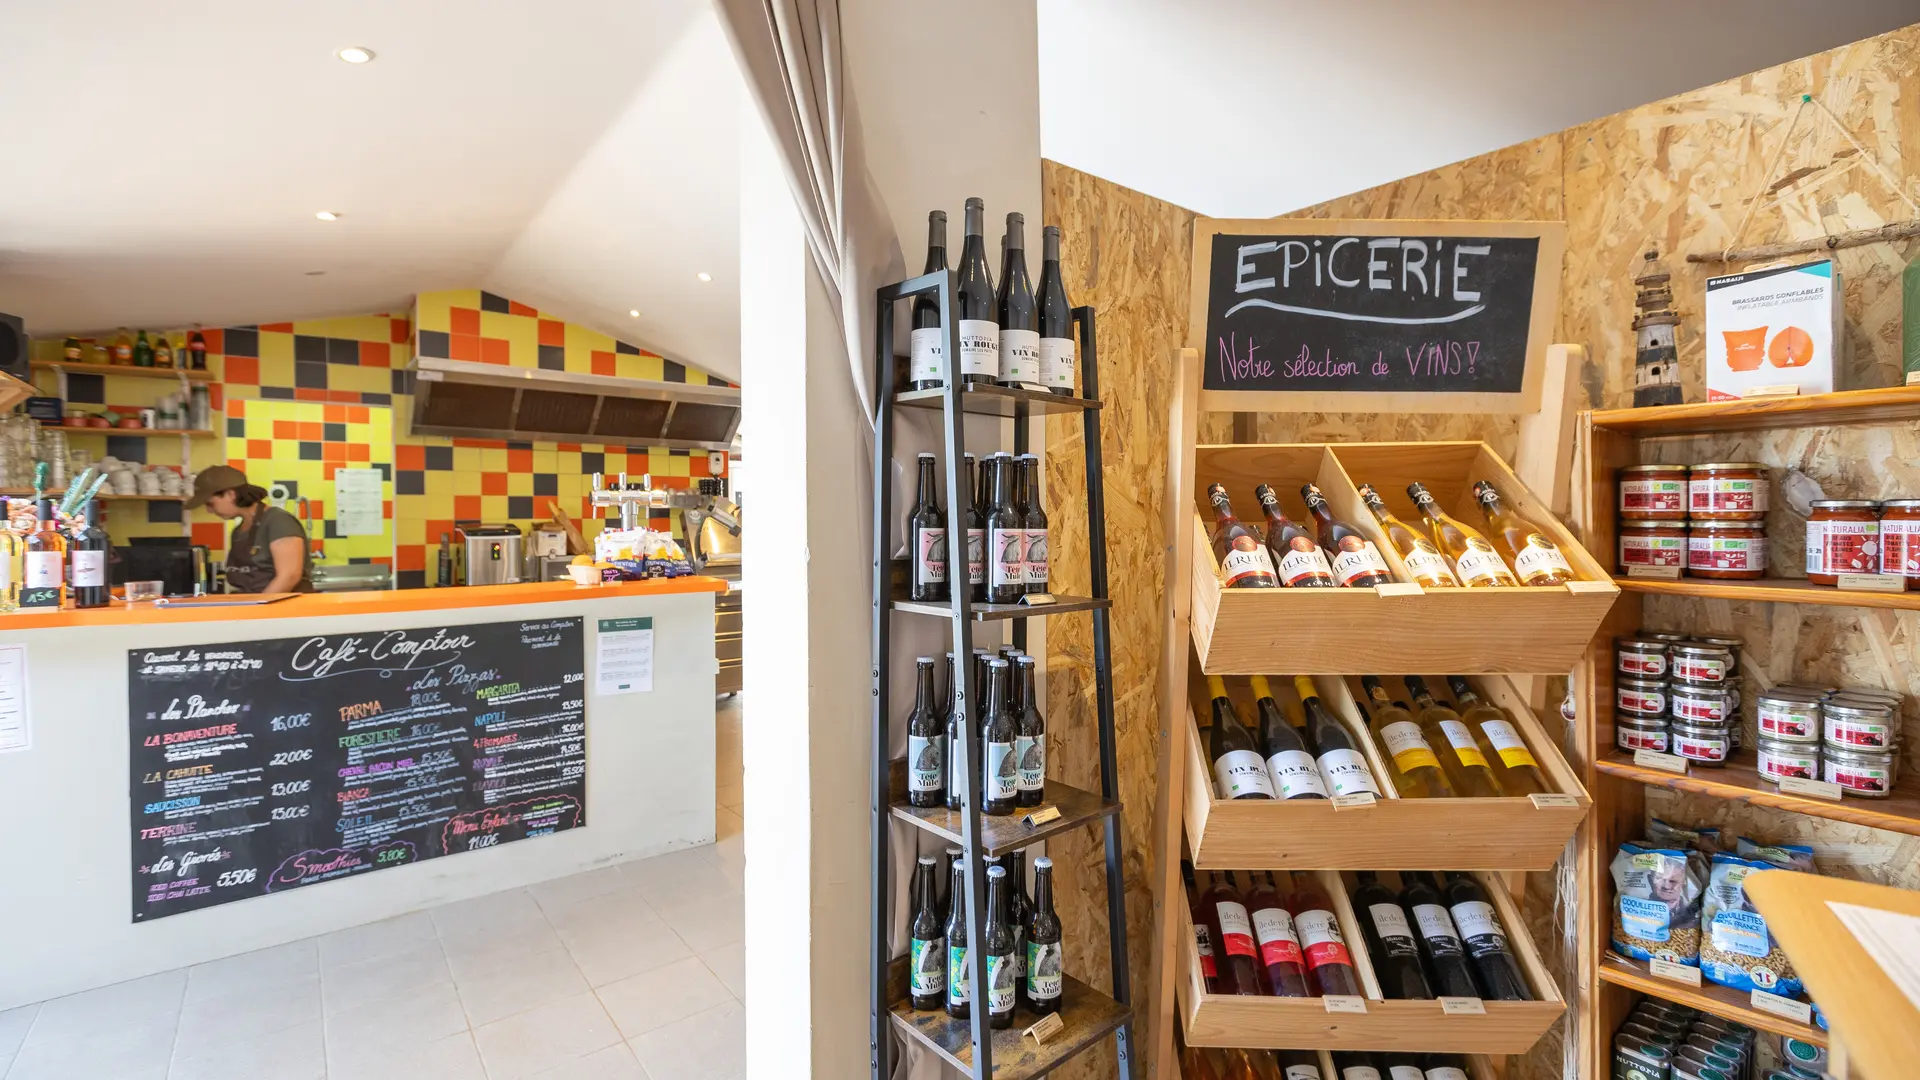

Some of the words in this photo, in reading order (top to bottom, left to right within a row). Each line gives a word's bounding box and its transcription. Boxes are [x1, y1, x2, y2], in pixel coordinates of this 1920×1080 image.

[1732, 294, 1775, 306] BRASSARDS
[1775, 286, 1825, 300] GONFLABLES
[1737, 300, 1779, 312] INFLATABLE
[1780, 293, 1824, 306] ARMBANDS
[1219, 331, 1276, 382] Notre
[1284, 344, 1360, 378] sélection
[1372, 351, 1390, 376] de
[476, 682, 521, 700] MARGARITA
[338, 700, 384, 722] PARMA
[144, 734, 161, 747] LA
[162, 723, 238, 746] BONAVENTURE
[142, 771, 162, 784] LA
[143, 796, 202, 815] SAUCISSON
[140, 821, 198, 840] TERRINE
[1621, 897, 1667, 913] COQUILLETTES
[1639, 909, 1665, 920] FRANCE
